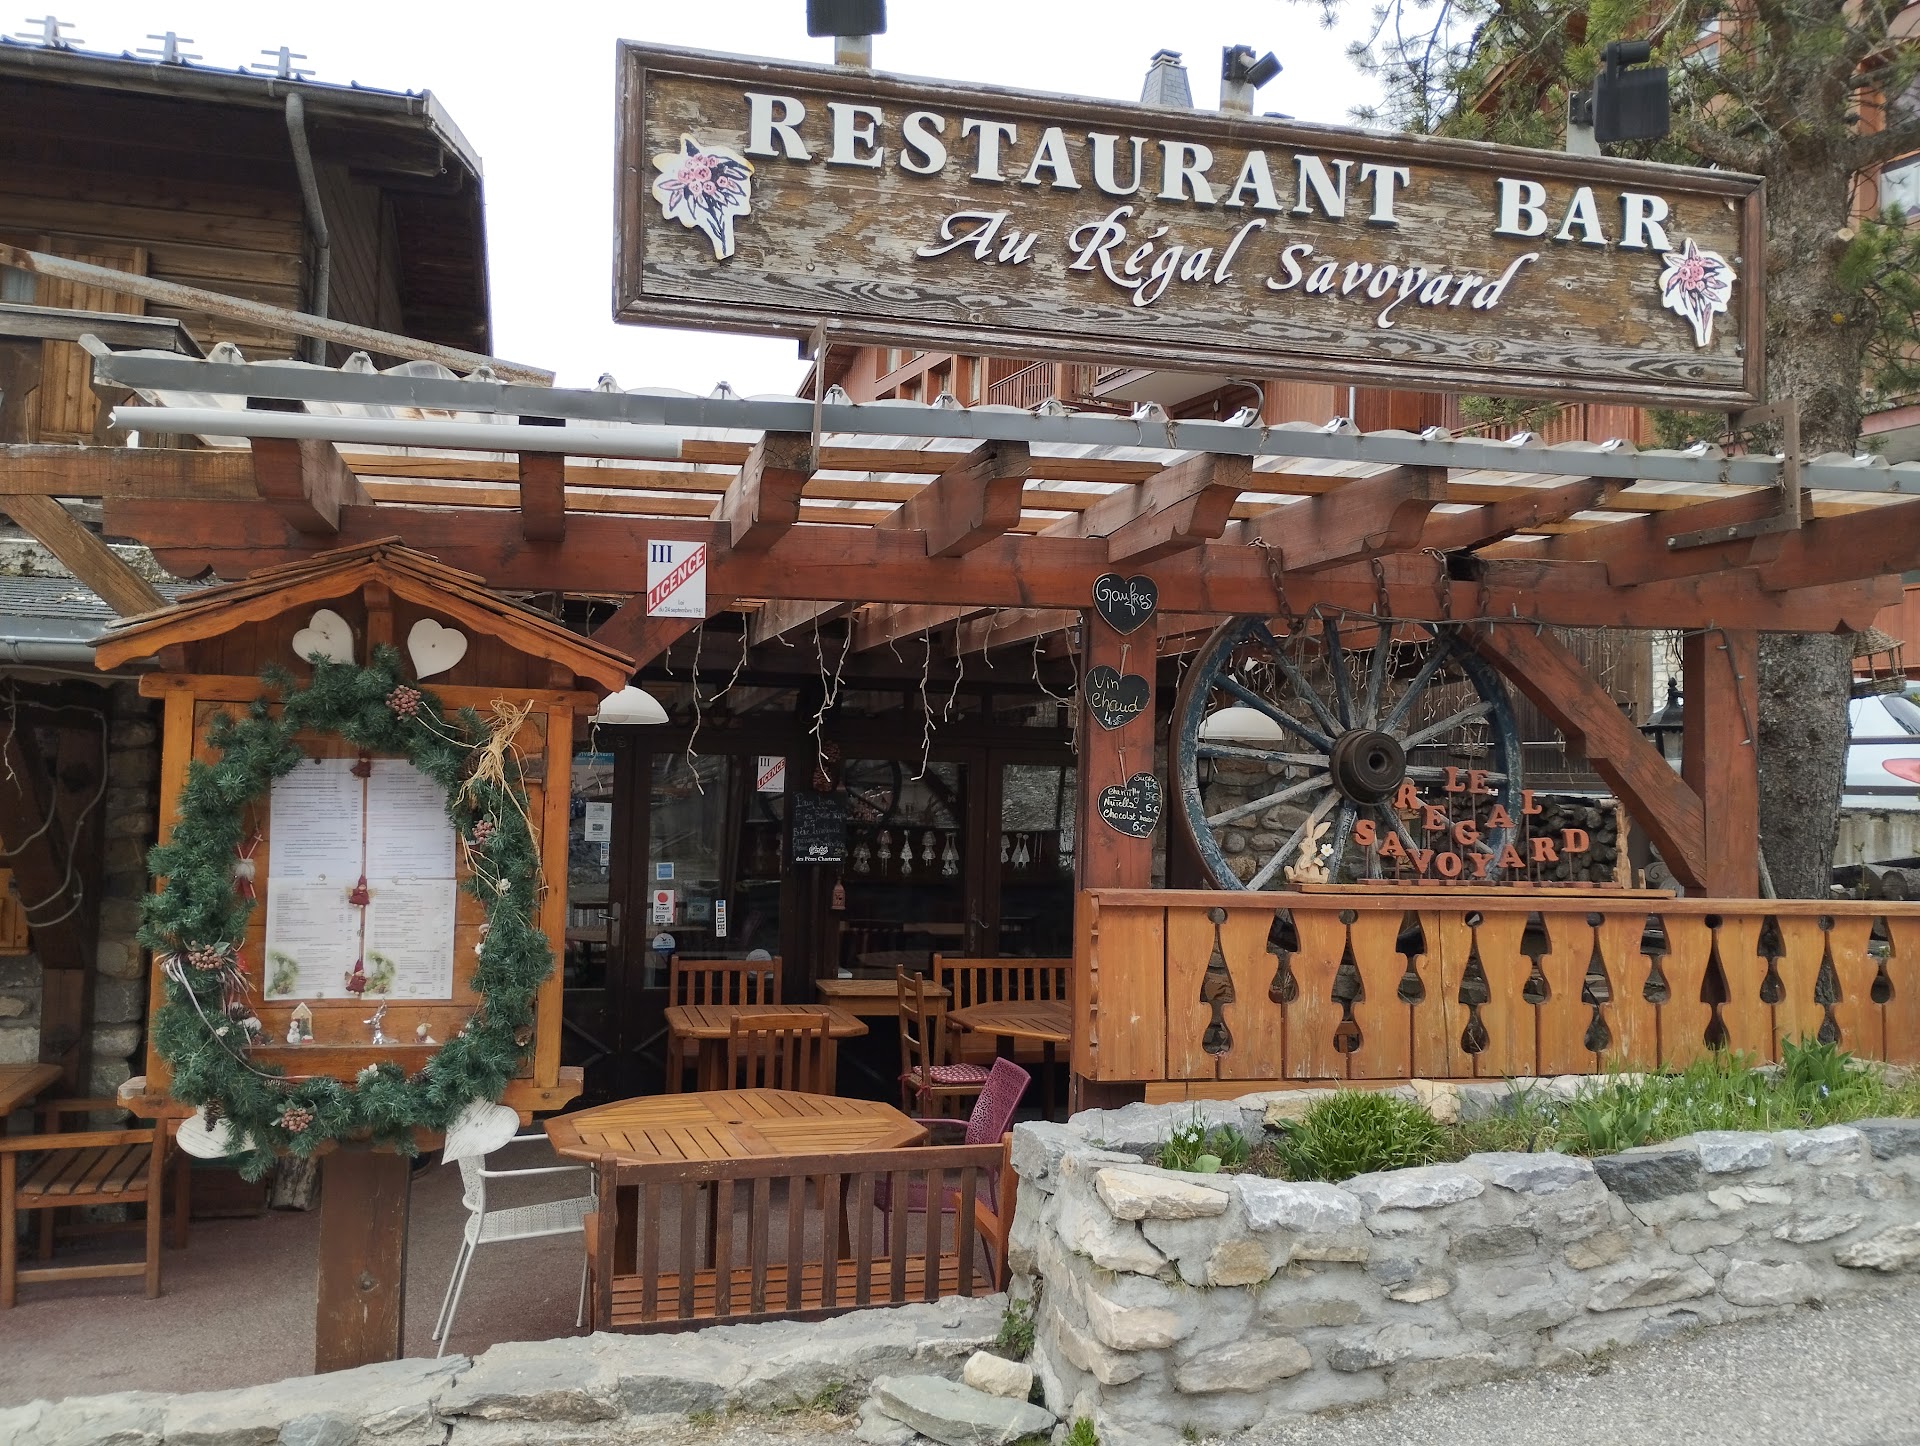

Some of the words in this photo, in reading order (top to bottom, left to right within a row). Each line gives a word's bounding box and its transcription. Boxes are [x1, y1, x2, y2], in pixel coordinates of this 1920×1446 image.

[744, 92, 1410, 227] RESTAURANT
[1494, 177, 1673, 251] BAR
[916, 210, 1039, 266] Au
[1068, 205, 1268, 308] Régal
[1267, 242, 1540, 329] Savoyard
[651, 544, 673, 563] III
[648, 547, 704, 611] LICENCE
[1093, 668, 1119, 691] Vin
[1091, 690, 1145, 713] Chaud
[758, 759, 785, 788] LICENCE
[760, 757, 770, 766] III
[1442, 766, 1489, 794] LE
[1103, 807, 1137, 821] Chocolat
[1393, 782, 1543, 846] REGAL
[1353, 818, 1590, 878] SAVOYARD
